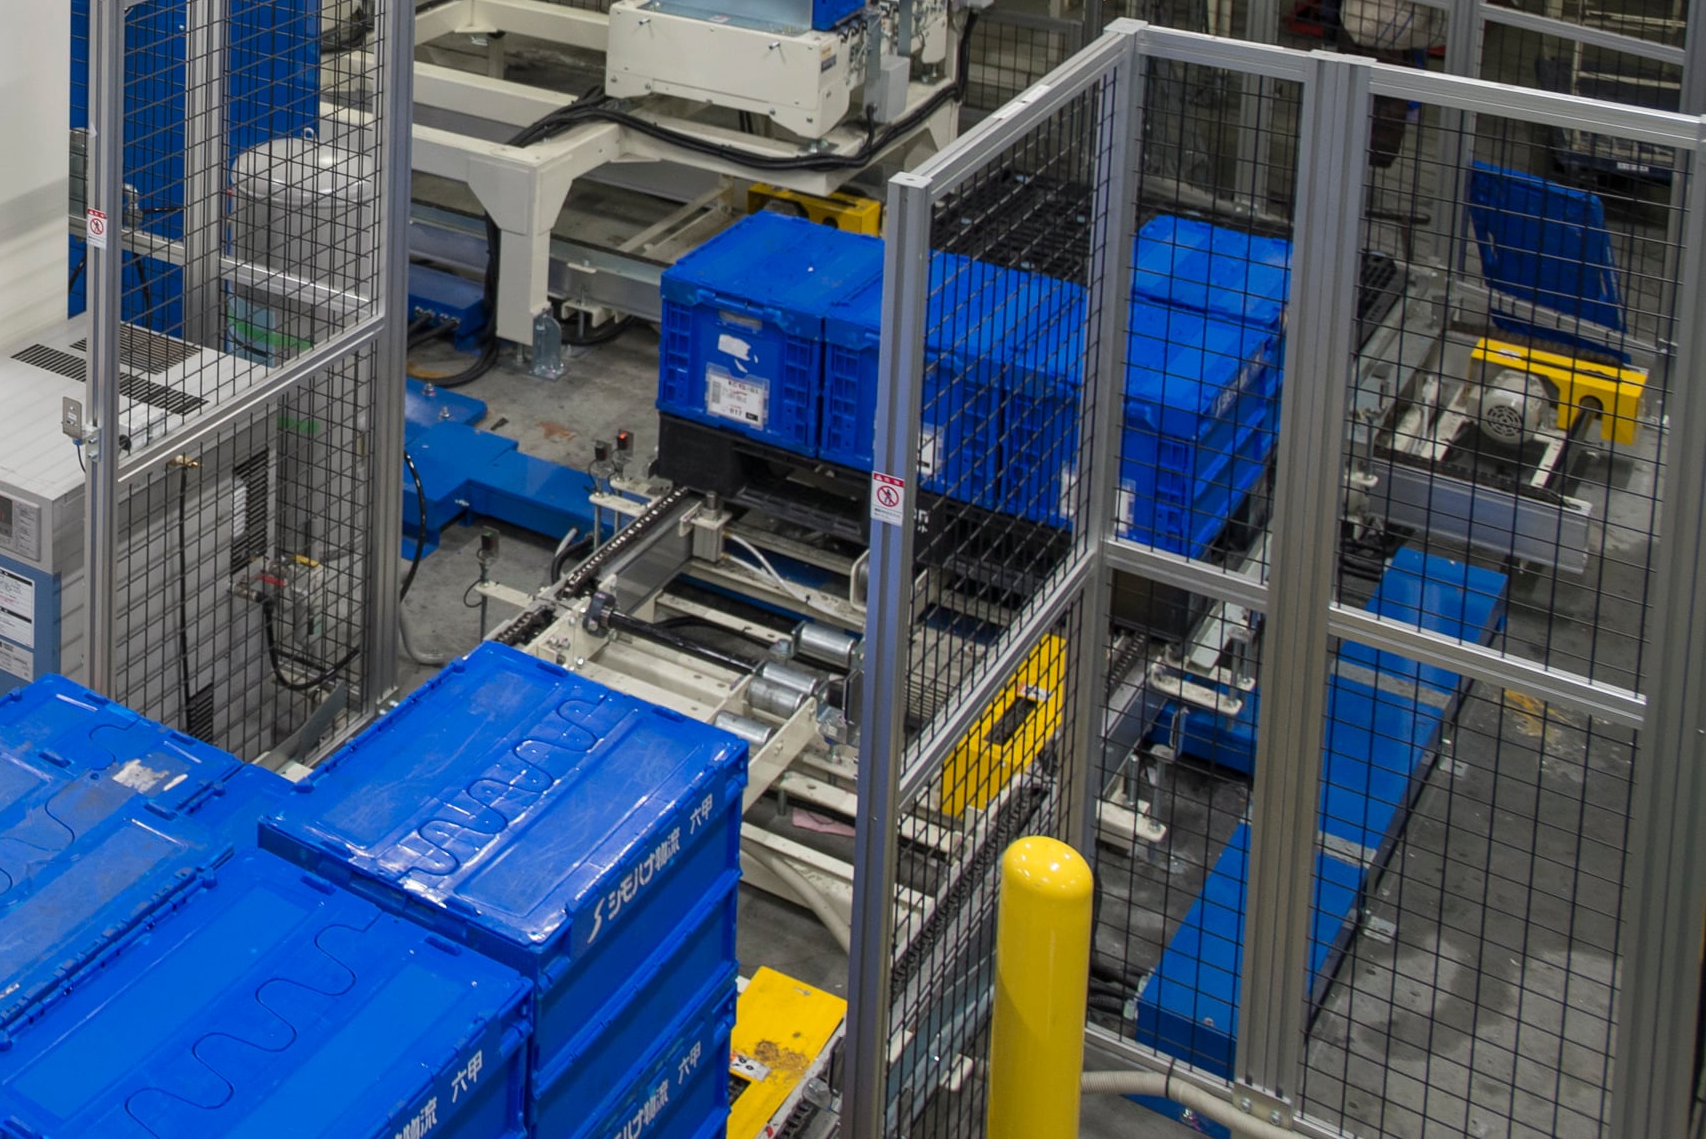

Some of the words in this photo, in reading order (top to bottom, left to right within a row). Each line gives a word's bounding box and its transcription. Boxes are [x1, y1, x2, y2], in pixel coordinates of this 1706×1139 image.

[608, 827, 681, 920] シモハナ物流
[690, 793, 713, 835] 六甲
[451, 1050, 483, 1103] 六甲
[678, 1041, 701, 1085] 六甲
